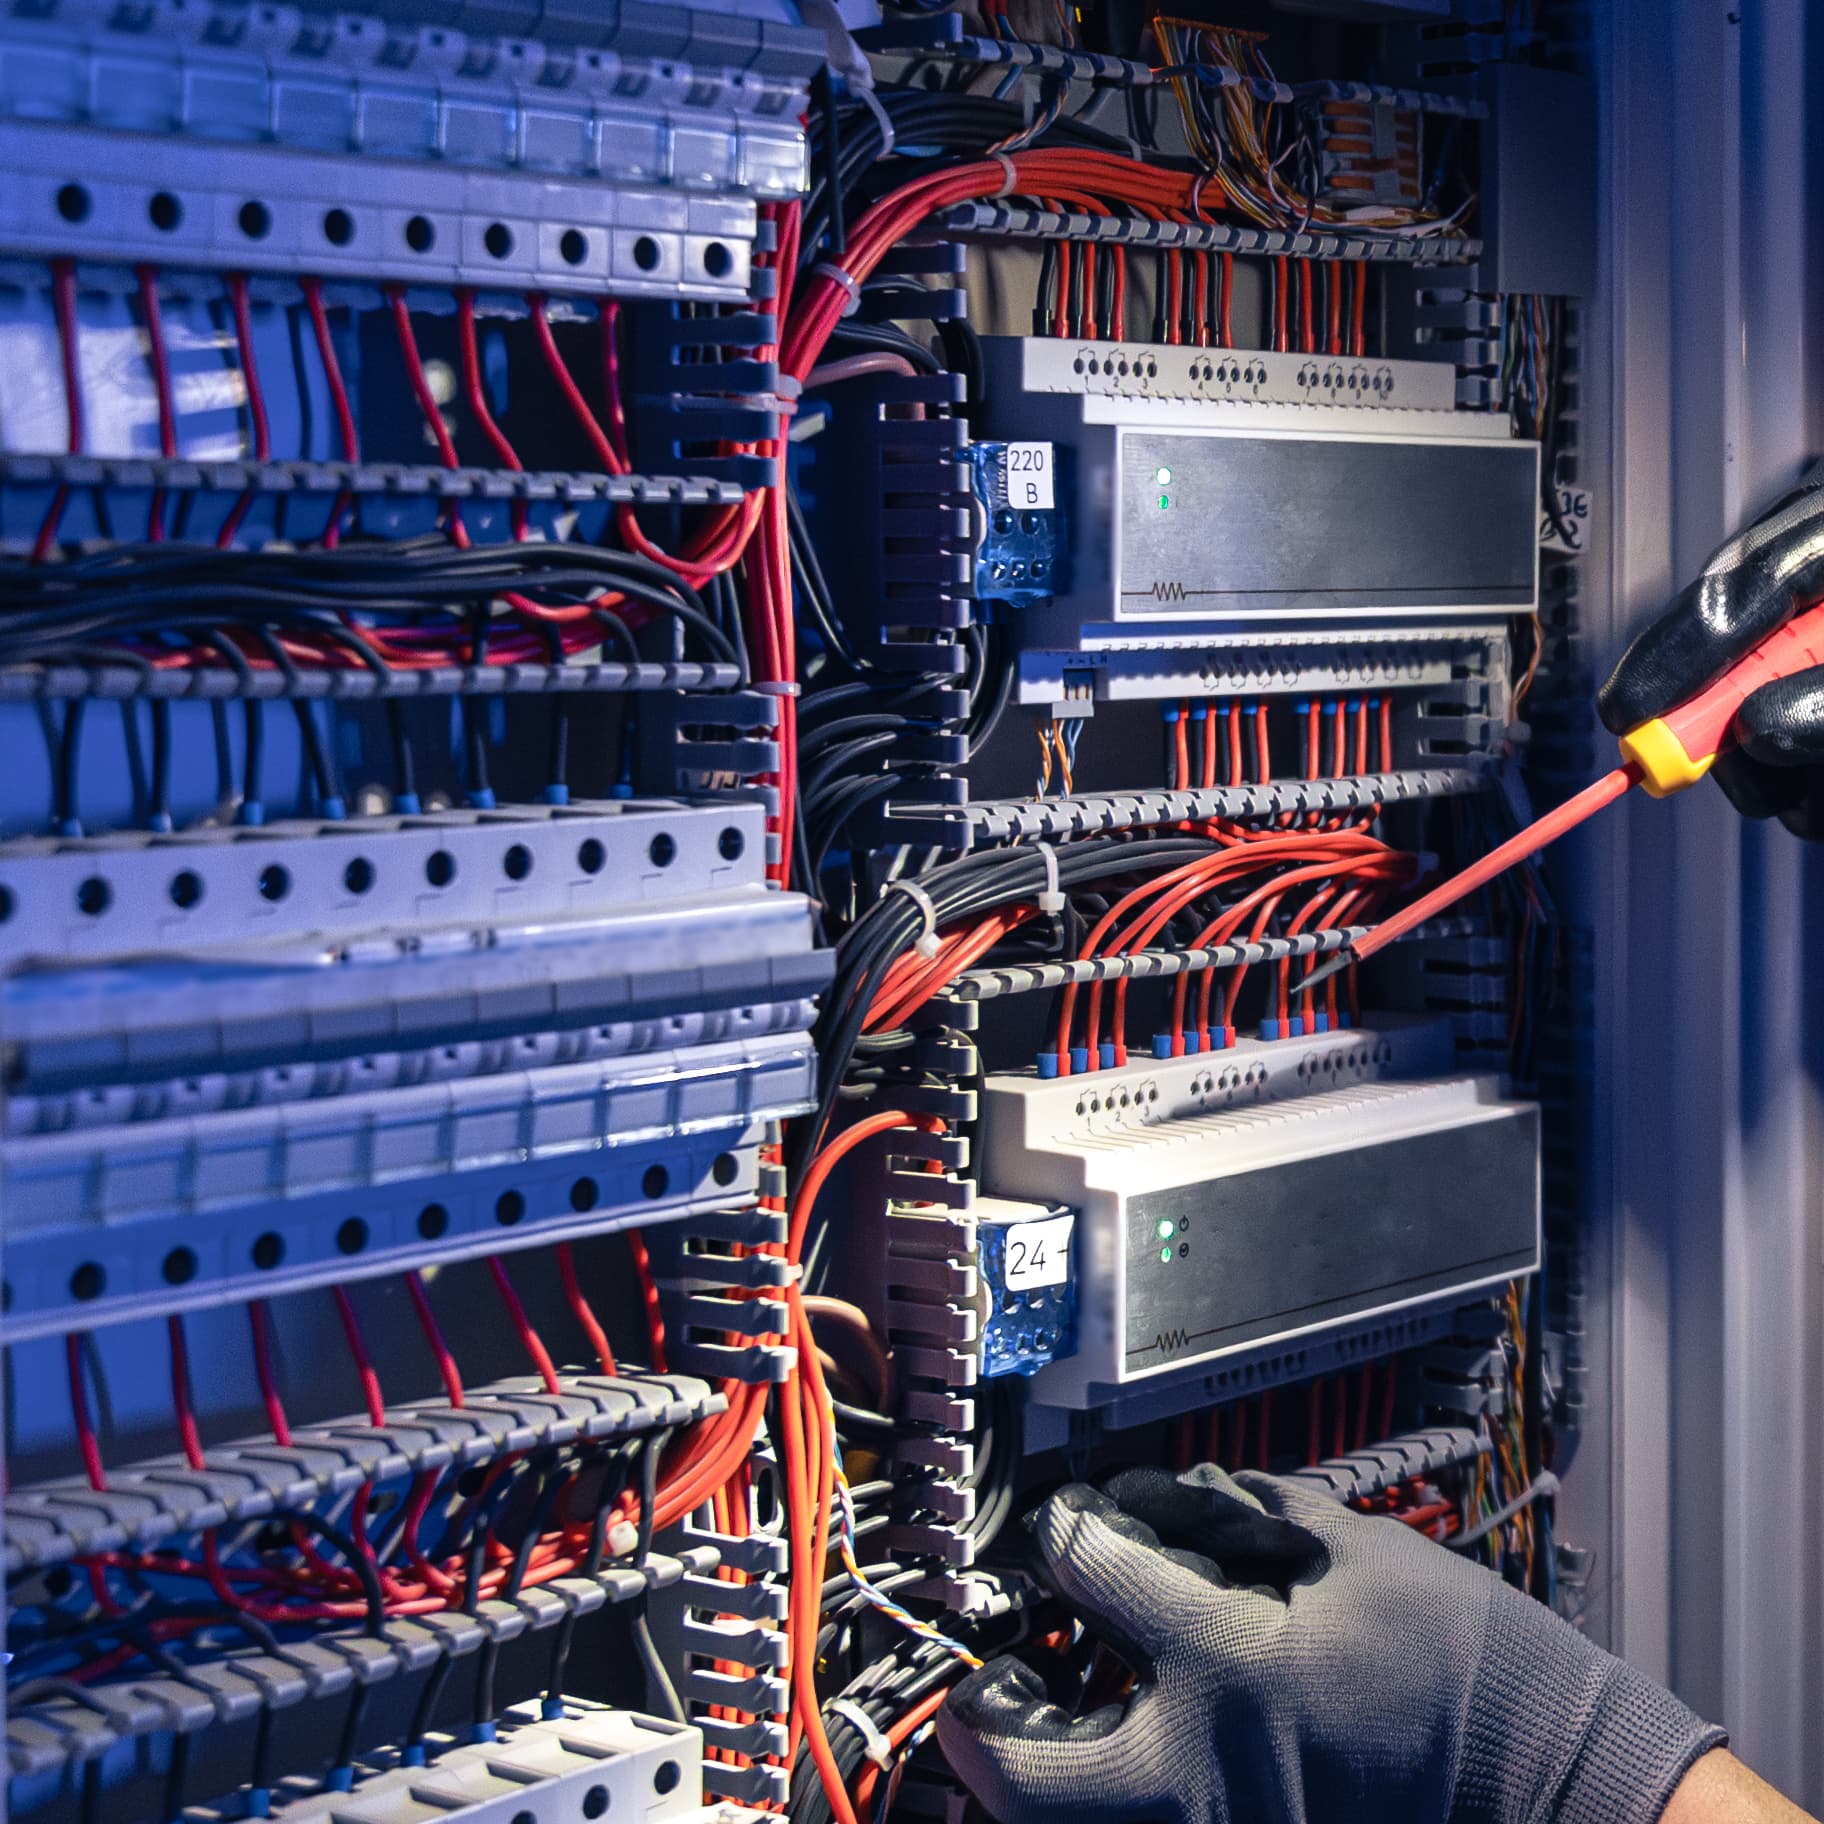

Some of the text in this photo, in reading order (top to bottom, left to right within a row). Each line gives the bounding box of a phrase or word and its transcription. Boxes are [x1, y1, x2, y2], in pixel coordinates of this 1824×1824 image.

[1010, 449, 1044, 472] 220
[1026, 482, 1039, 504] B
[1010, 1239, 1047, 1276] 24
